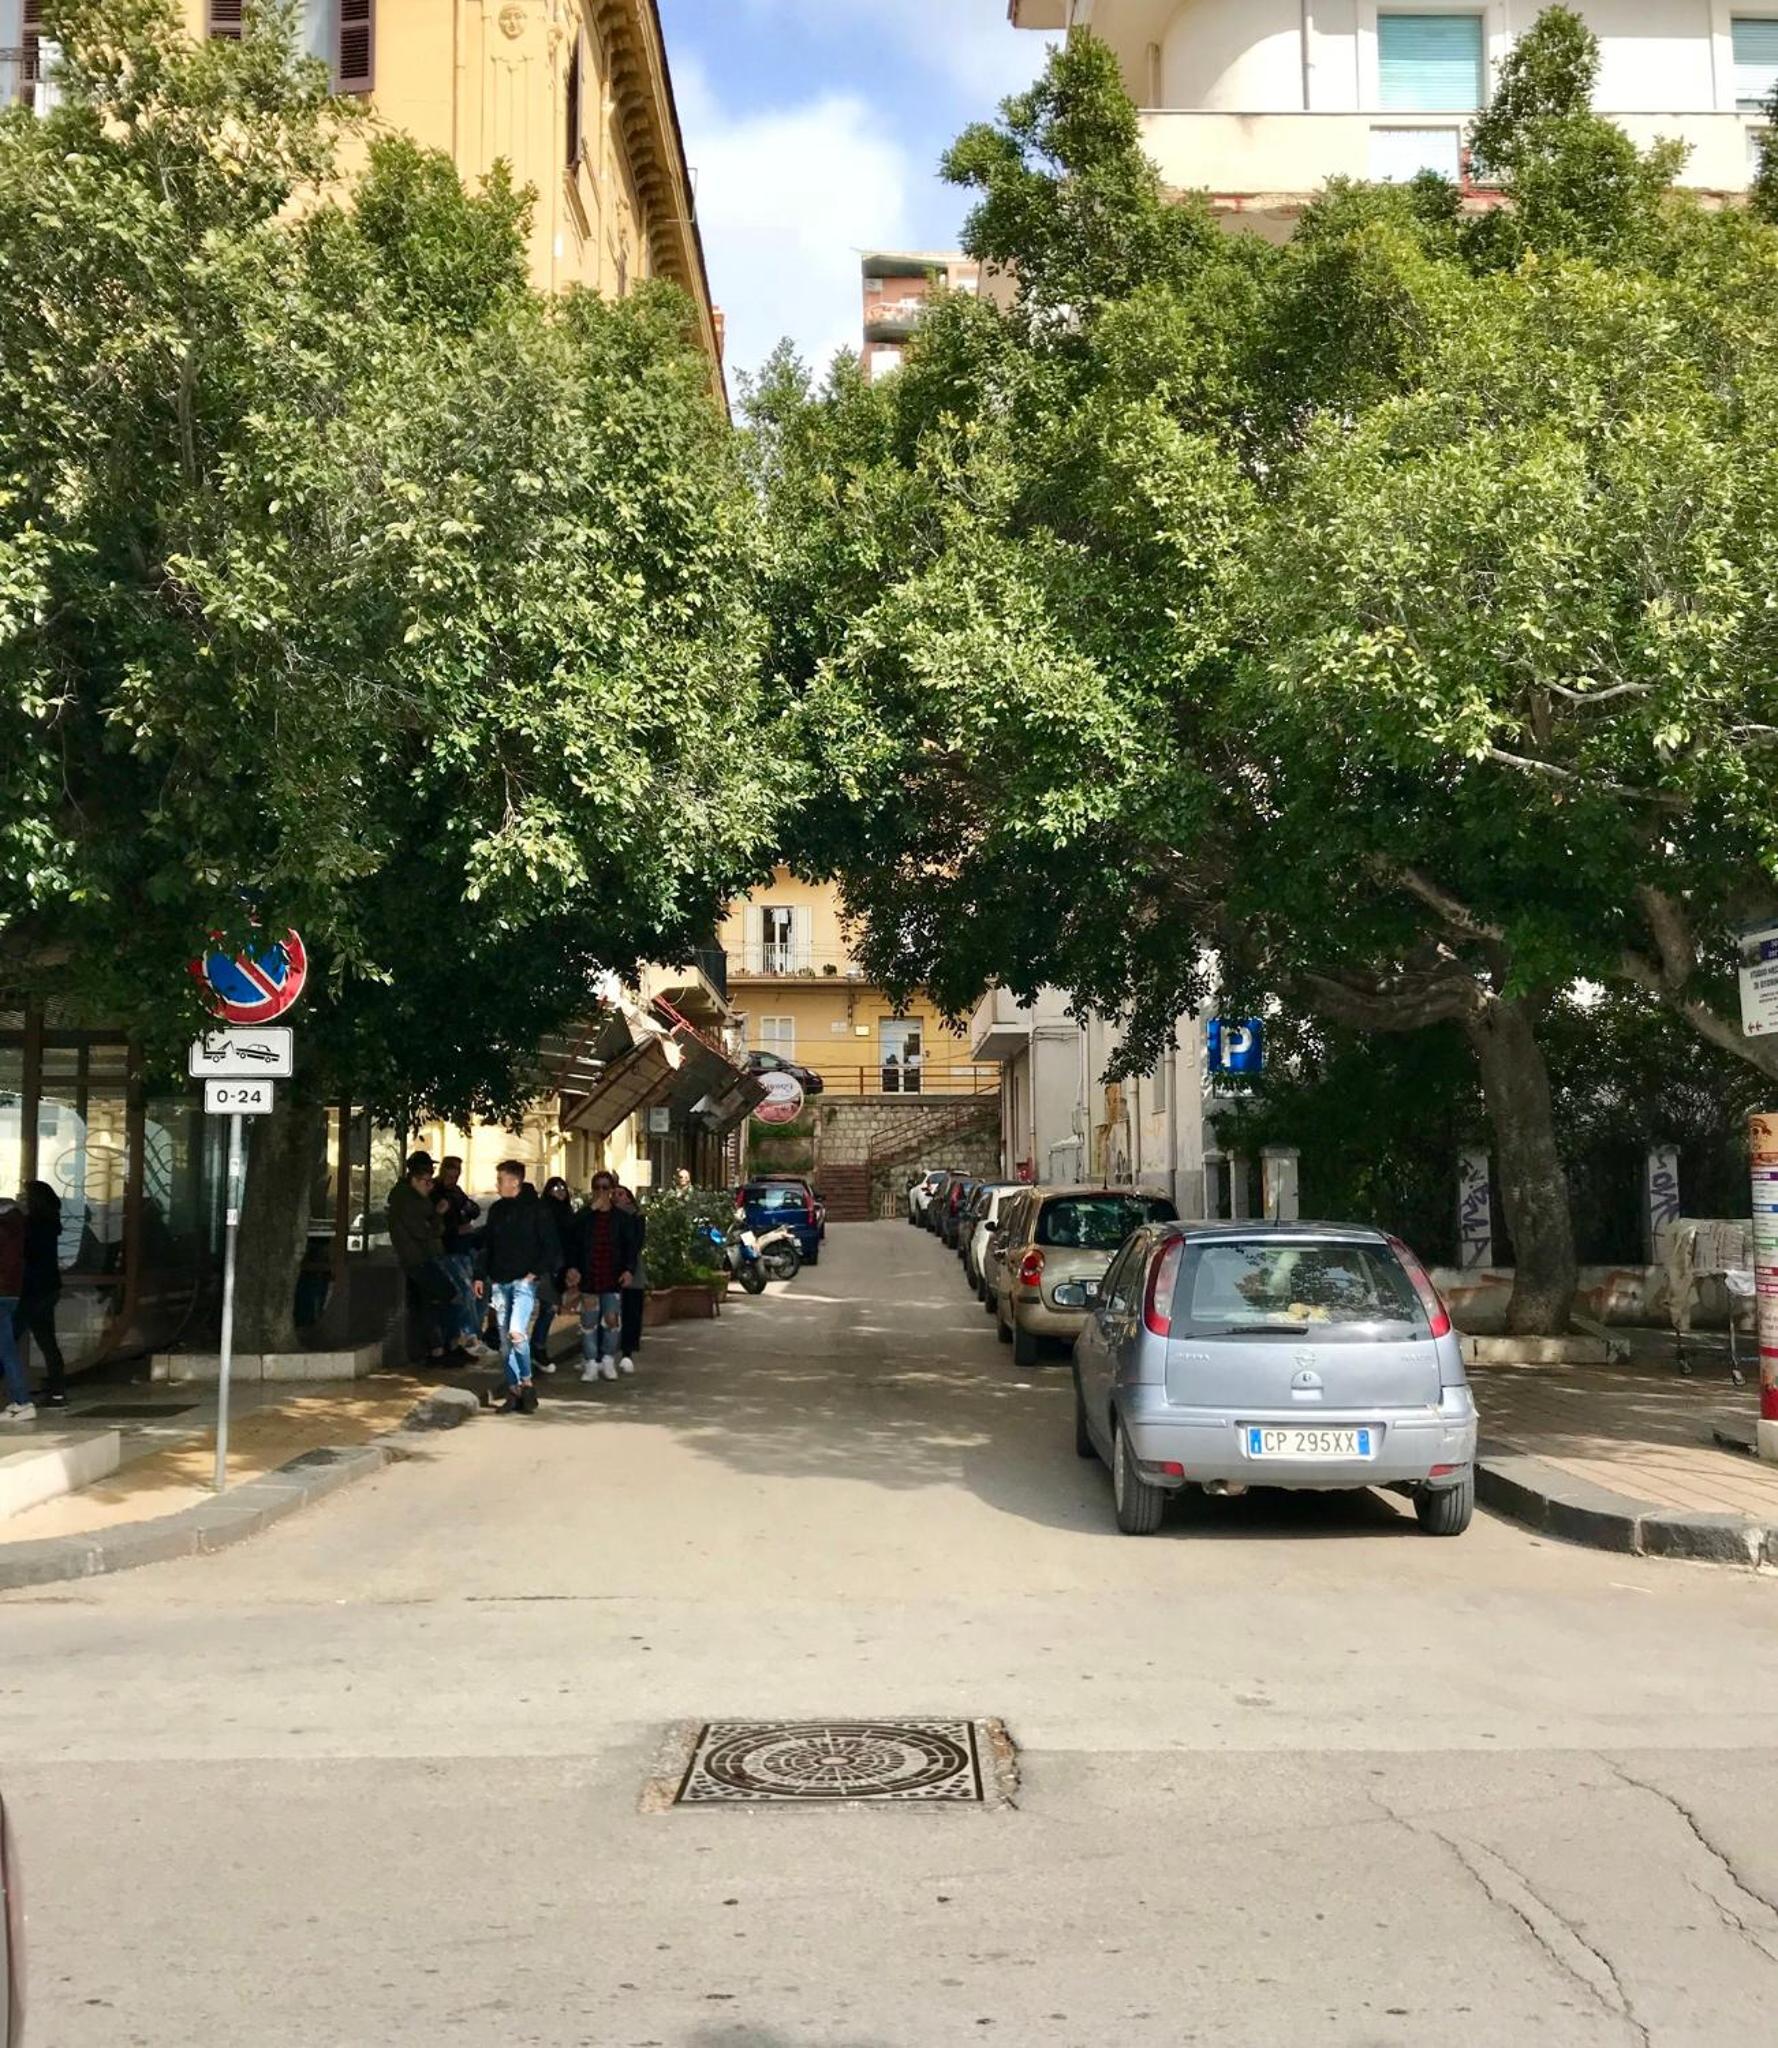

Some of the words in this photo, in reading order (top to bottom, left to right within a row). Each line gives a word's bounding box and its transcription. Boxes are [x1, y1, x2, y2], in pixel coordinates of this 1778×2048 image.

[1221, 1026, 1252, 1067] P
[216, 1089, 262, 1104] 0-24
[1264, 1432, 1287, 1452] CP
[1295, 1432, 1356, 1453] 295XX
